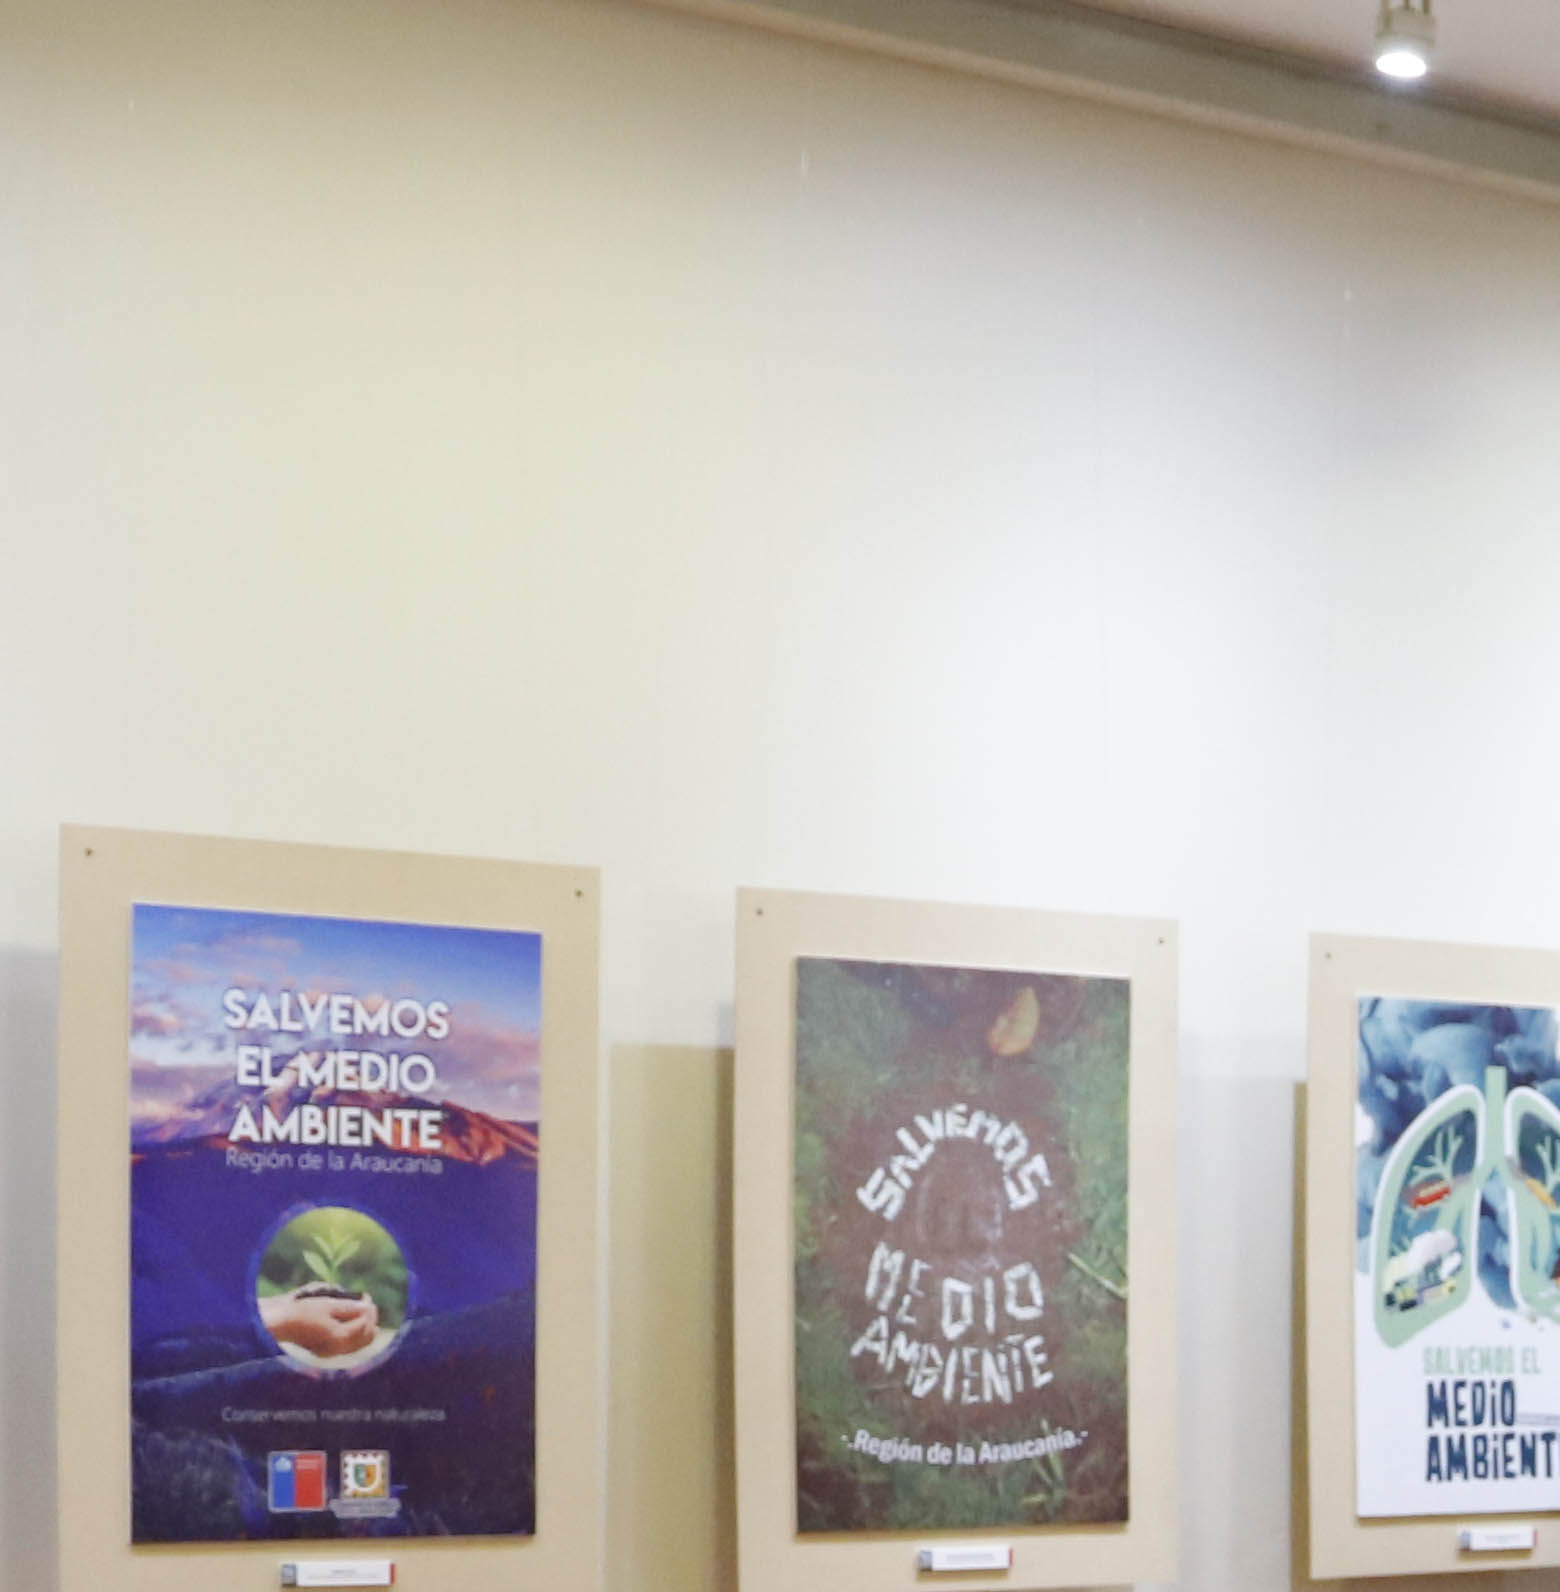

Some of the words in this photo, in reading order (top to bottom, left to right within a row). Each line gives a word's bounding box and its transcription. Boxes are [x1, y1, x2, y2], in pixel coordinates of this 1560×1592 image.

[222, 987, 451, 1040] SALVEMOS
[236, 1045, 283, 1087] EL
[297, 1051, 436, 1094] MEDIO
[228, 1105, 443, 1149] AMBIENTE
[225, 1146, 292, 1174] Región
[297, 1151, 323, 1169] de
[328, 1151, 345, 1170] la
[855, 1102, 1053, 1222] SALVEMOS
[864, 1241, 1044, 1341] MEDIO
[850, 1314, 1055, 1405] AMBIENTE
[927, 1442, 952, 1465] de
[956, 1442, 976, 1464] la
